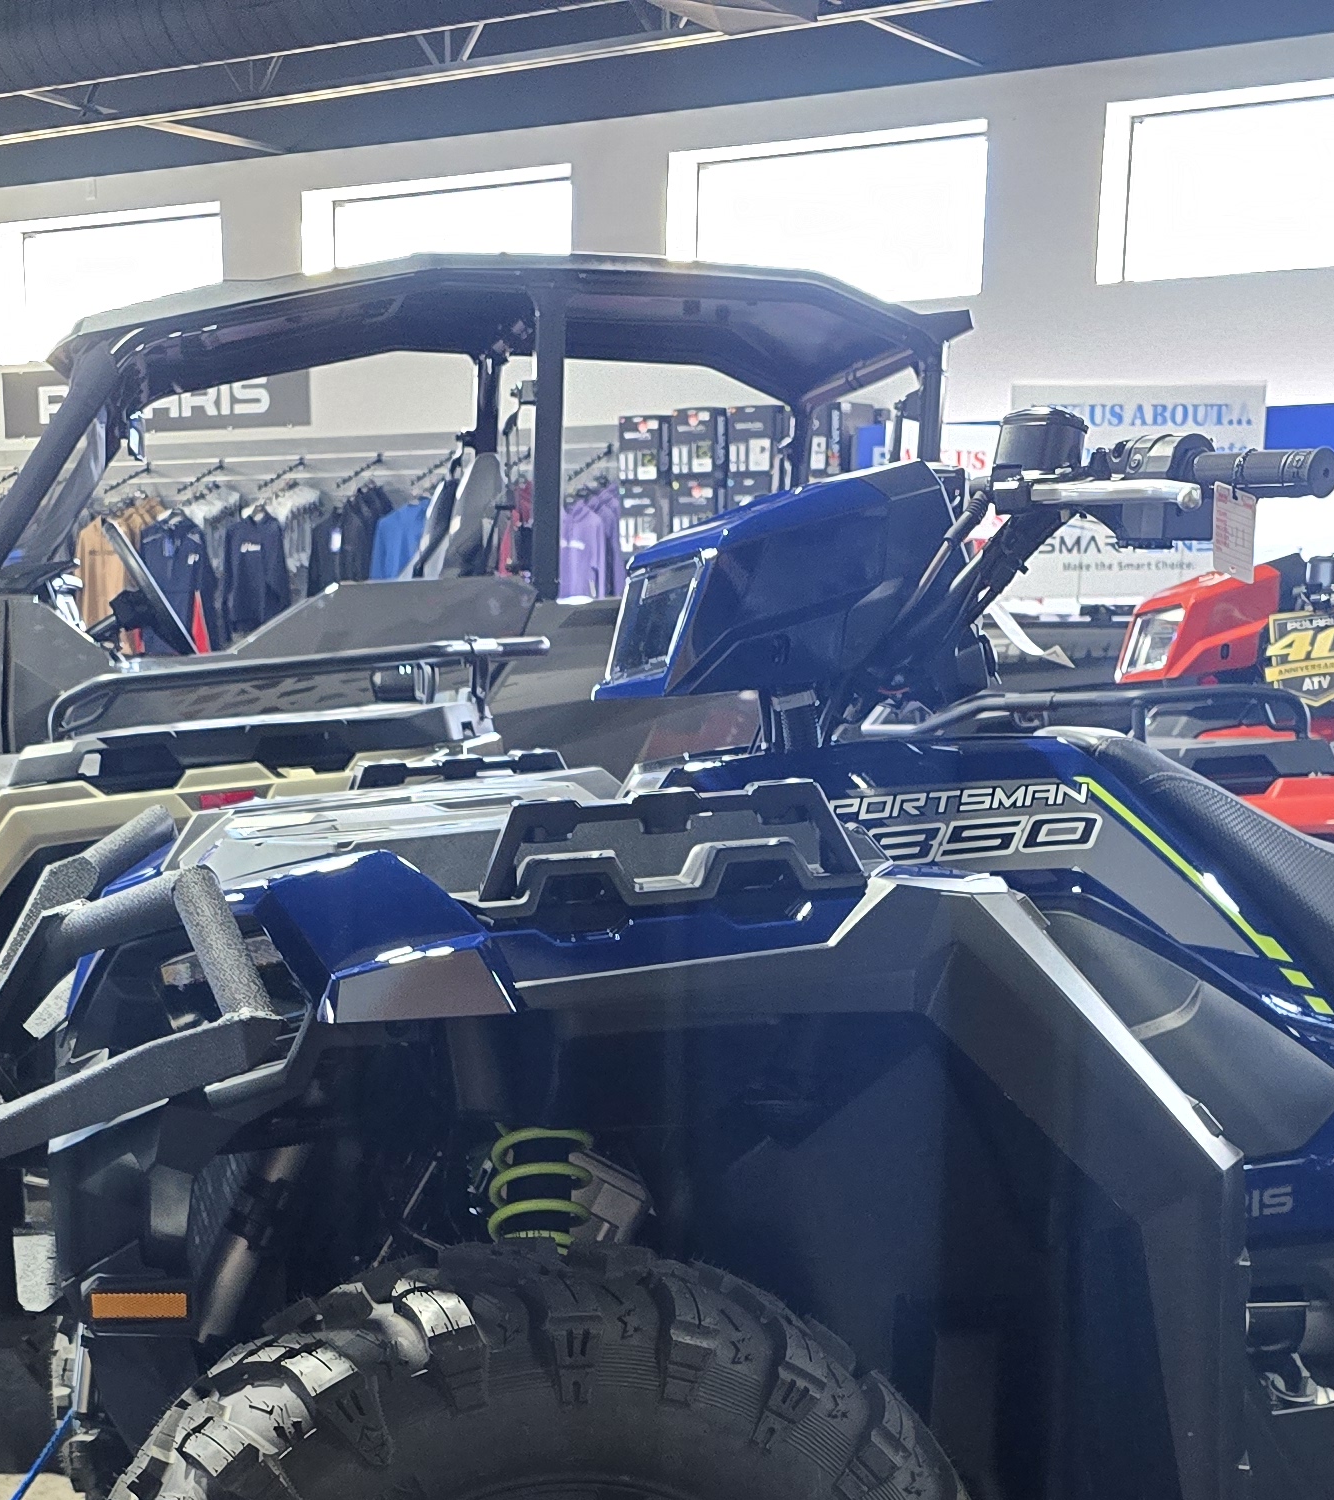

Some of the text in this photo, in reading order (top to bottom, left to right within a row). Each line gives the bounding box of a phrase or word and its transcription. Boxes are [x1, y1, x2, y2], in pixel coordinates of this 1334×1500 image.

[38, 377, 271, 426] PARIS
[1089, 403, 1124, 427] US
[1095, 561, 1113, 571] the
[1118, 561, 1152, 571] Smart
[1302, 675, 1331, 691] ATV
[830, 782, 1089, 820] PORTSMAN
